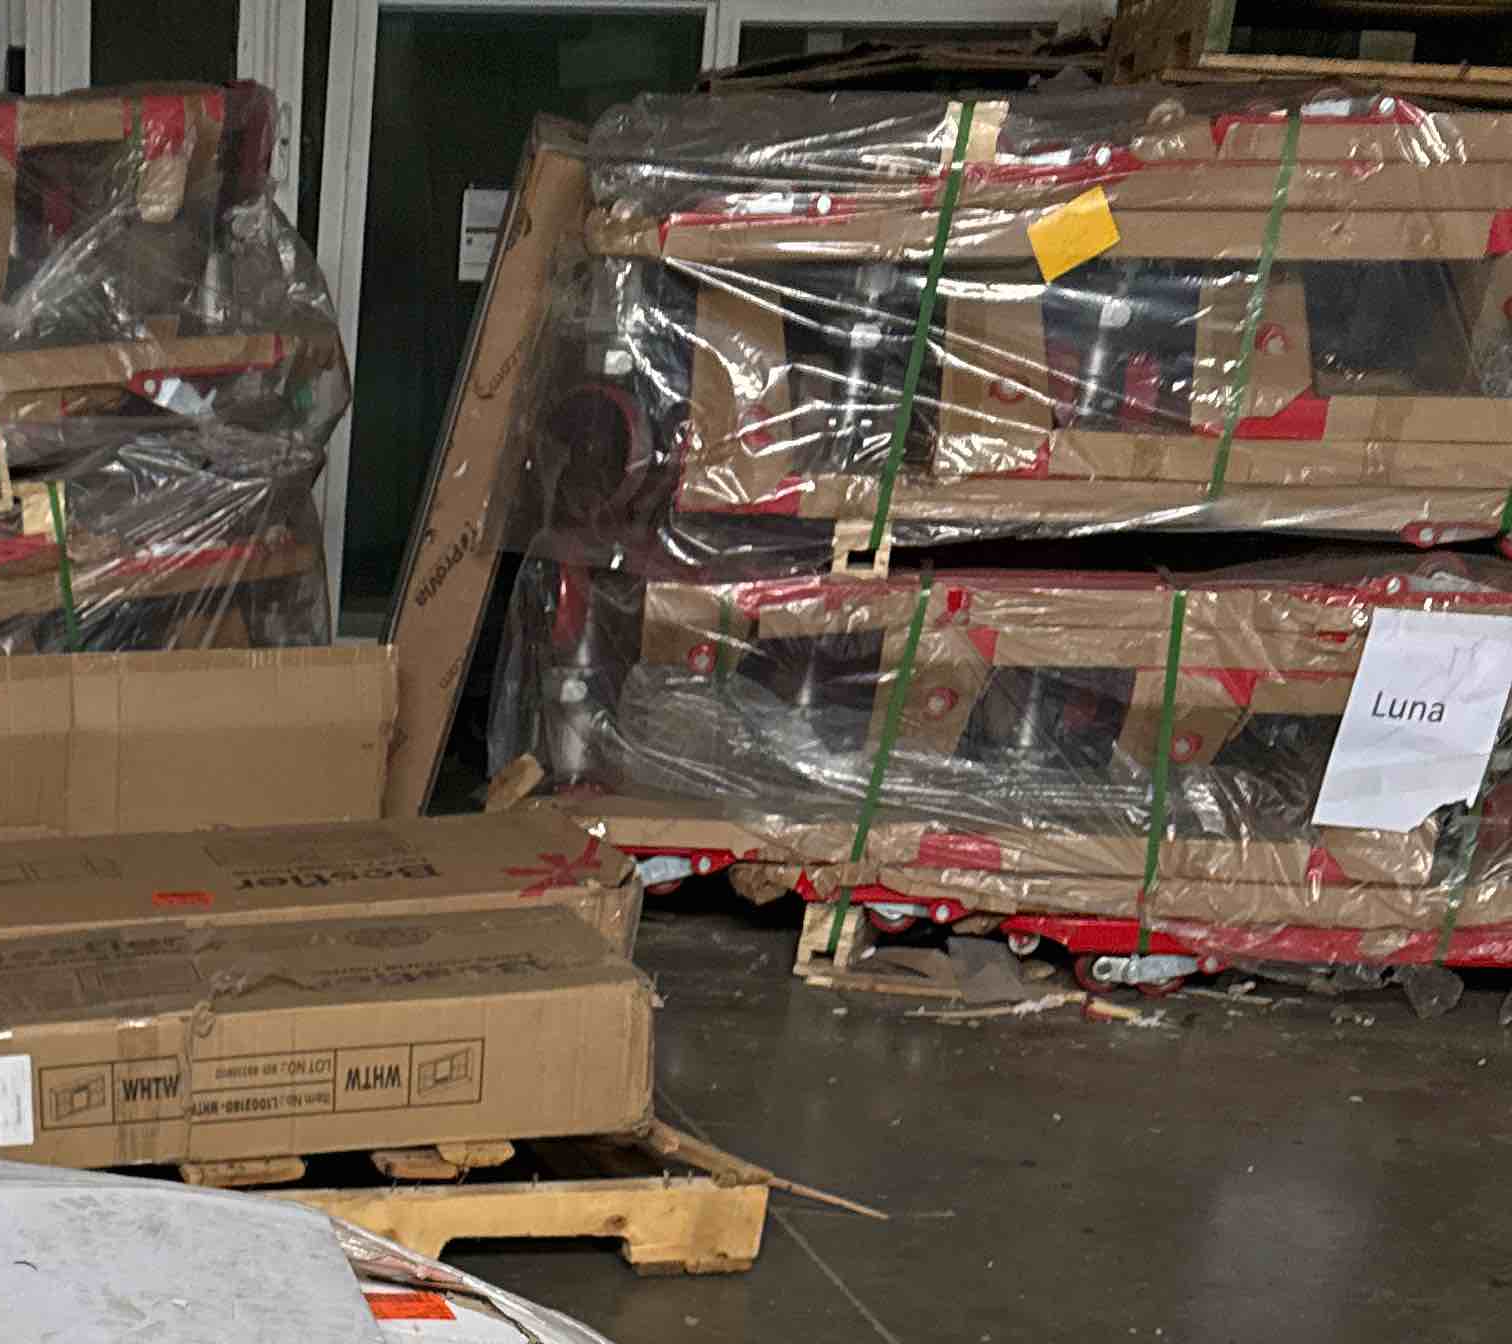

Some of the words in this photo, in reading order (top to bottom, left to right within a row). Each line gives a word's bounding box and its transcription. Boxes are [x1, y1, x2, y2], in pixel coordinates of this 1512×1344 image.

[1371, 689, 1445, 722] Luna
[122, 1072, 182, 1101] WHTW
[344, 1064, 402, 1092] WHTW
